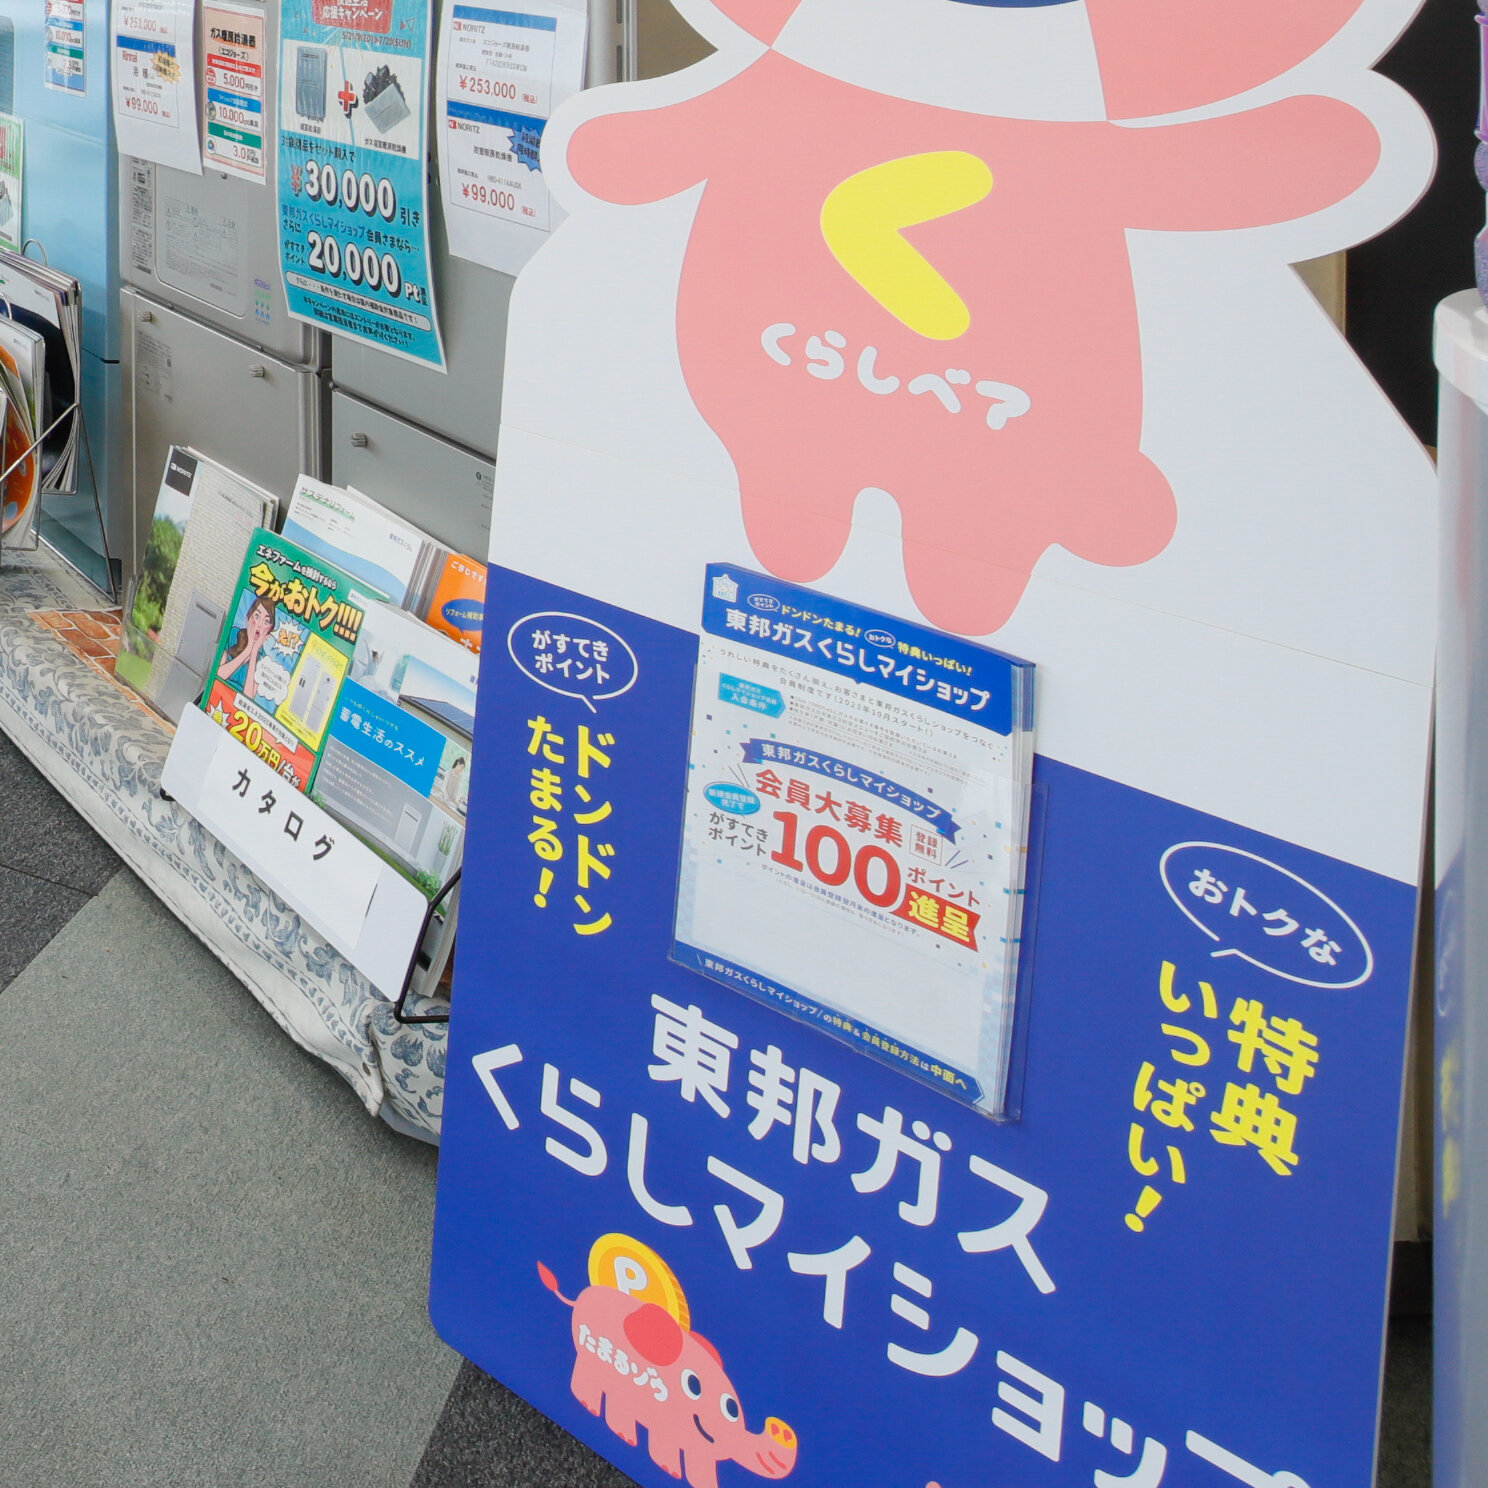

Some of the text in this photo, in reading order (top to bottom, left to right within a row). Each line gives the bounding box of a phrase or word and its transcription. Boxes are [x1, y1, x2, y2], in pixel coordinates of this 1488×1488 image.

[462, 23, 486, 35] NORITZ
[458, 74, 517, 101] ¥253,000
[457, 122, 481, 135] NORITZ
[291, 158, 397, 223] ¥30,000
[461, 183, 516, 212] ¥99,000
[307, 229, 403, 299] 20,000
[760, 321, 1031, 431] くらしベア
[531, 627, 610, 664] がすてき
[532, 654, 613, 689] ポイント
[725, 607, 991, 712] 東邦ガスくらしマイショップ
[781, 604, 973, 678] ドンドンたまる! 特典いっぱい!
[339, 708, 425, 768] 蓄電生活のススメ
[525, 714, 565, 911] たまる!
[755, 769, 904, 849] 会員大募集
[761, 742, 943, 819] 東邦ガスくらしマイショップ
[232, 768, 336, 862] カタログ
[570, 720, 618, 939] ドンドン
[707, 825, 768, 857] ポイント
[709, 811, 769, 844] がすてき
[915, 829, 938, 845] 登録
[770, 811, 902, 909] 100
[914, 842, 938, 859] 無料
[906, 866, 981, 907] ポイント
[908, 890, 972, 943] 進呈
[1185, 865, 1346, 968] おトクな
[703, 958, 819, 1016] 東邦ガスくらしマイショップ
[1122, 960, 1219, 1234] いっぱい!
[1209, 997, 1321, 1178] 特典
[648, 993, 1057, 1295] 東邦ガス
[576, 1320, 670, 1405] たまるゾウ
